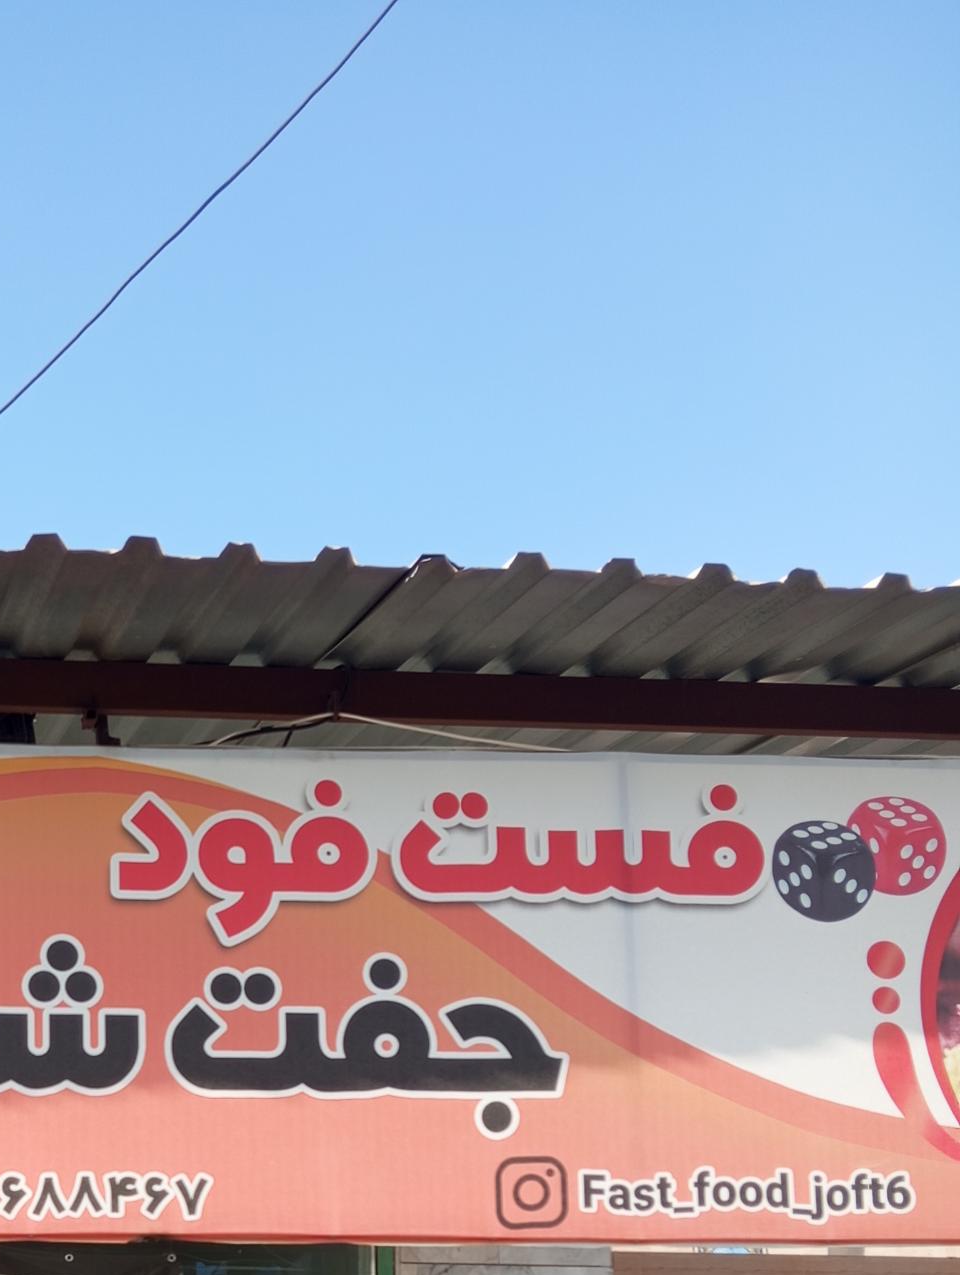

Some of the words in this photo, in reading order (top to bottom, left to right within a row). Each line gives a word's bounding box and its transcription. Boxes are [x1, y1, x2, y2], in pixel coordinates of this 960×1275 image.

[117, 779, 370, 939] فود
[398, 781, 766, 899] فست
[169, 955, 565, 1134] جفت
[581, 1171, 911, 1222] Fast_food_joft6
